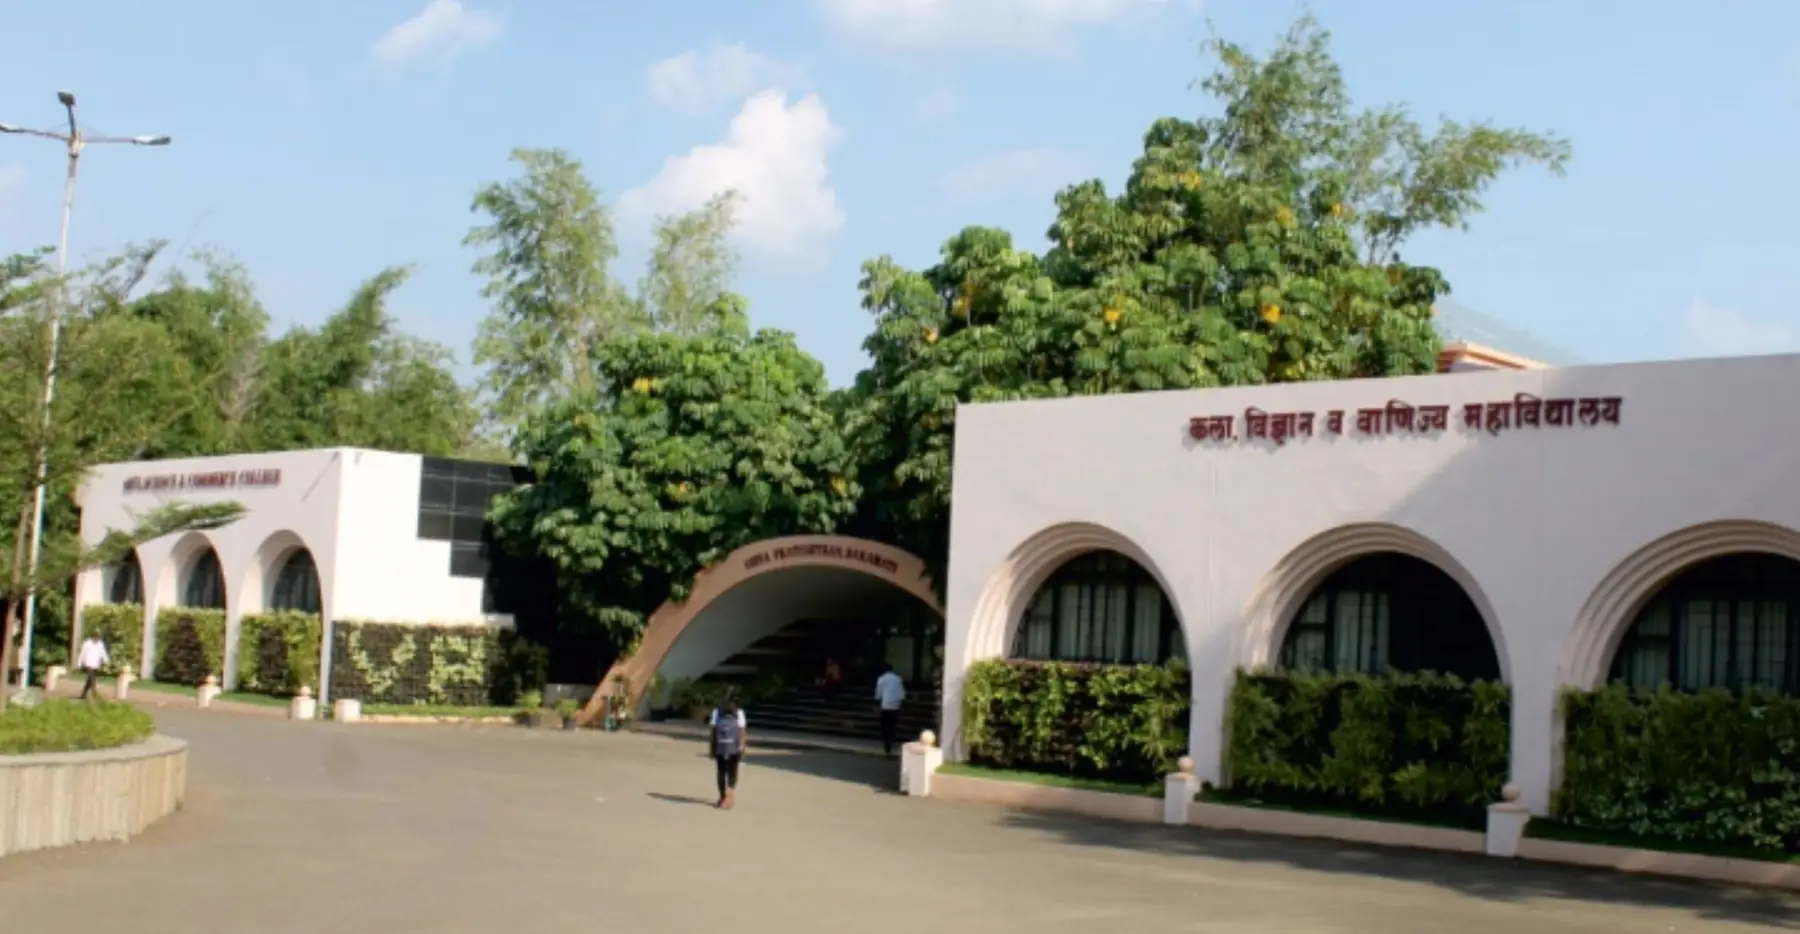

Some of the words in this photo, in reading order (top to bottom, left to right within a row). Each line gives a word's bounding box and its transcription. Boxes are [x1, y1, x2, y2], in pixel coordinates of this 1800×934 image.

[1245, 405, 1315, 446] विज्ञान
[1328, 410, 1344, 435] व
[1357, 399, 1449, 435] वाणिज्य
[1464, 392, 1622, 437] महाविद्यालय
